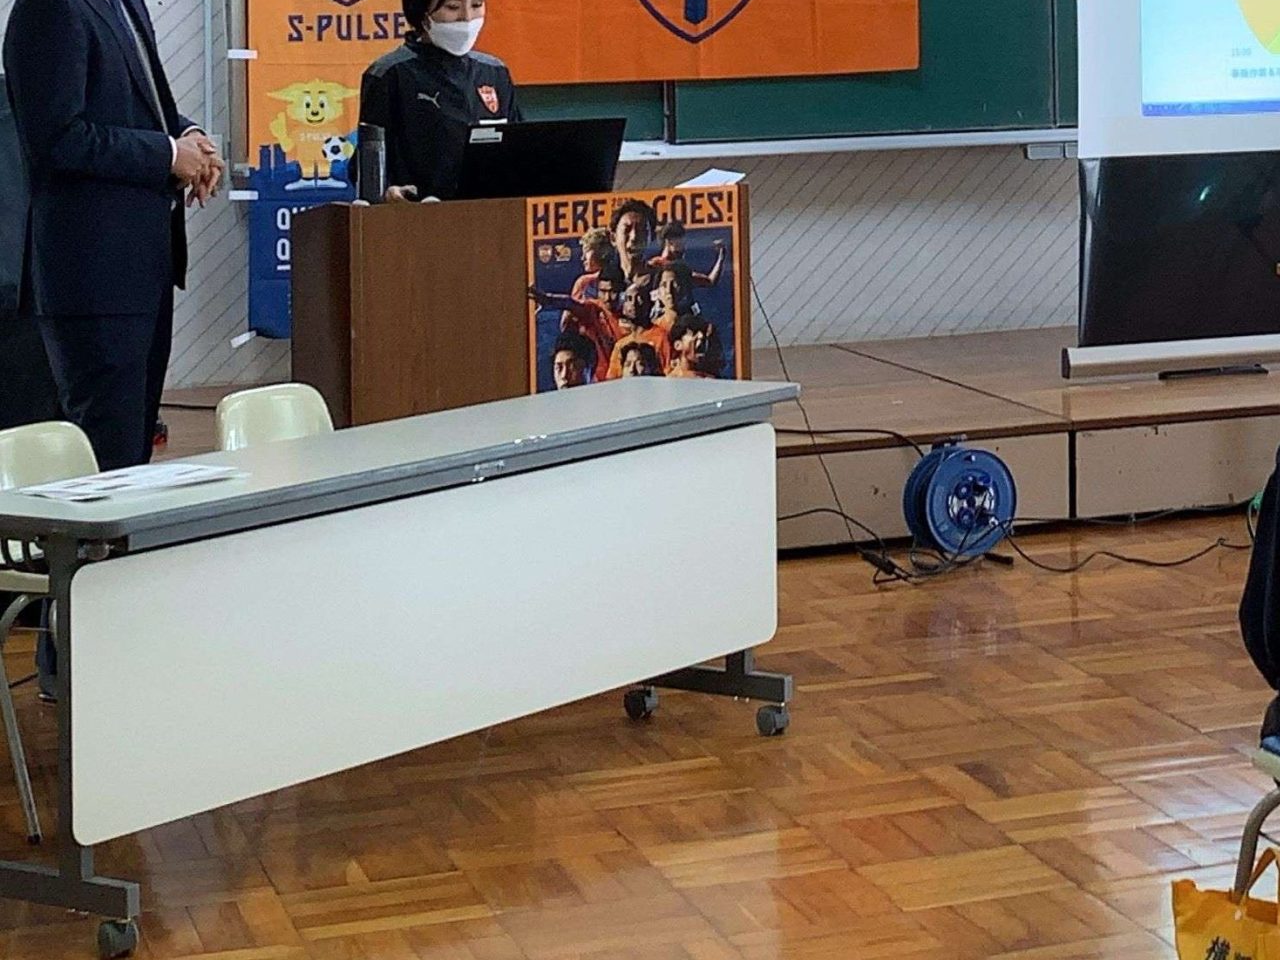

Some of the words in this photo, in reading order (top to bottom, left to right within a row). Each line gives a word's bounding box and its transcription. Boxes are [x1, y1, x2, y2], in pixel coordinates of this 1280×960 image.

[287, 12, 406, 42] S-PULSE
[532, 198, 608, 236] HERE
[652, 191, 733, 226] GOES!
